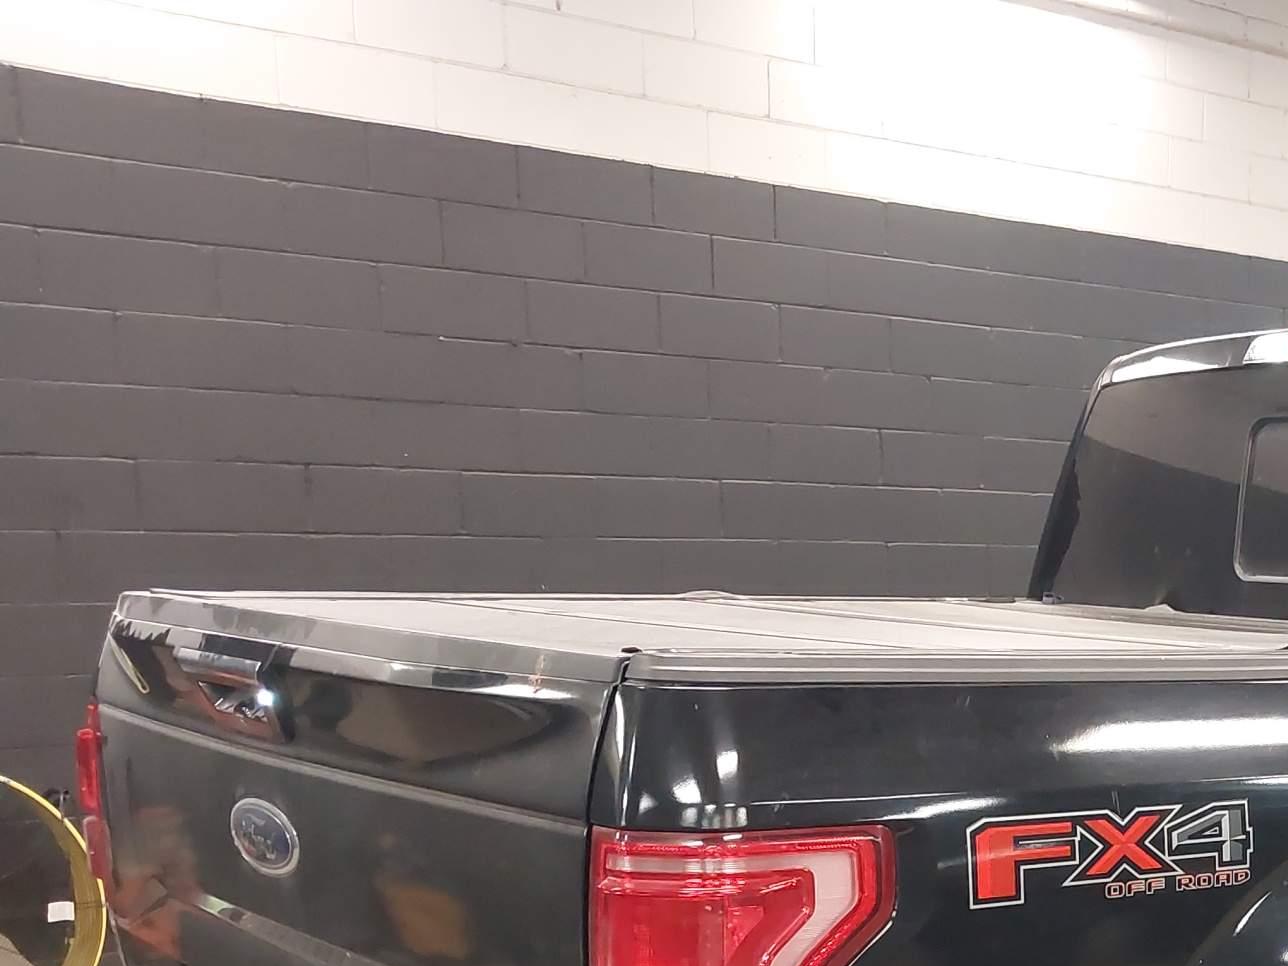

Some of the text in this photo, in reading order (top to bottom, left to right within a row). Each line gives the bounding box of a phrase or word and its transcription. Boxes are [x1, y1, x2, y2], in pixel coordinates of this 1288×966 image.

[966, 799, 1253, 910] FX4
[1104, 869, 1251, 899] OFF ROAD
